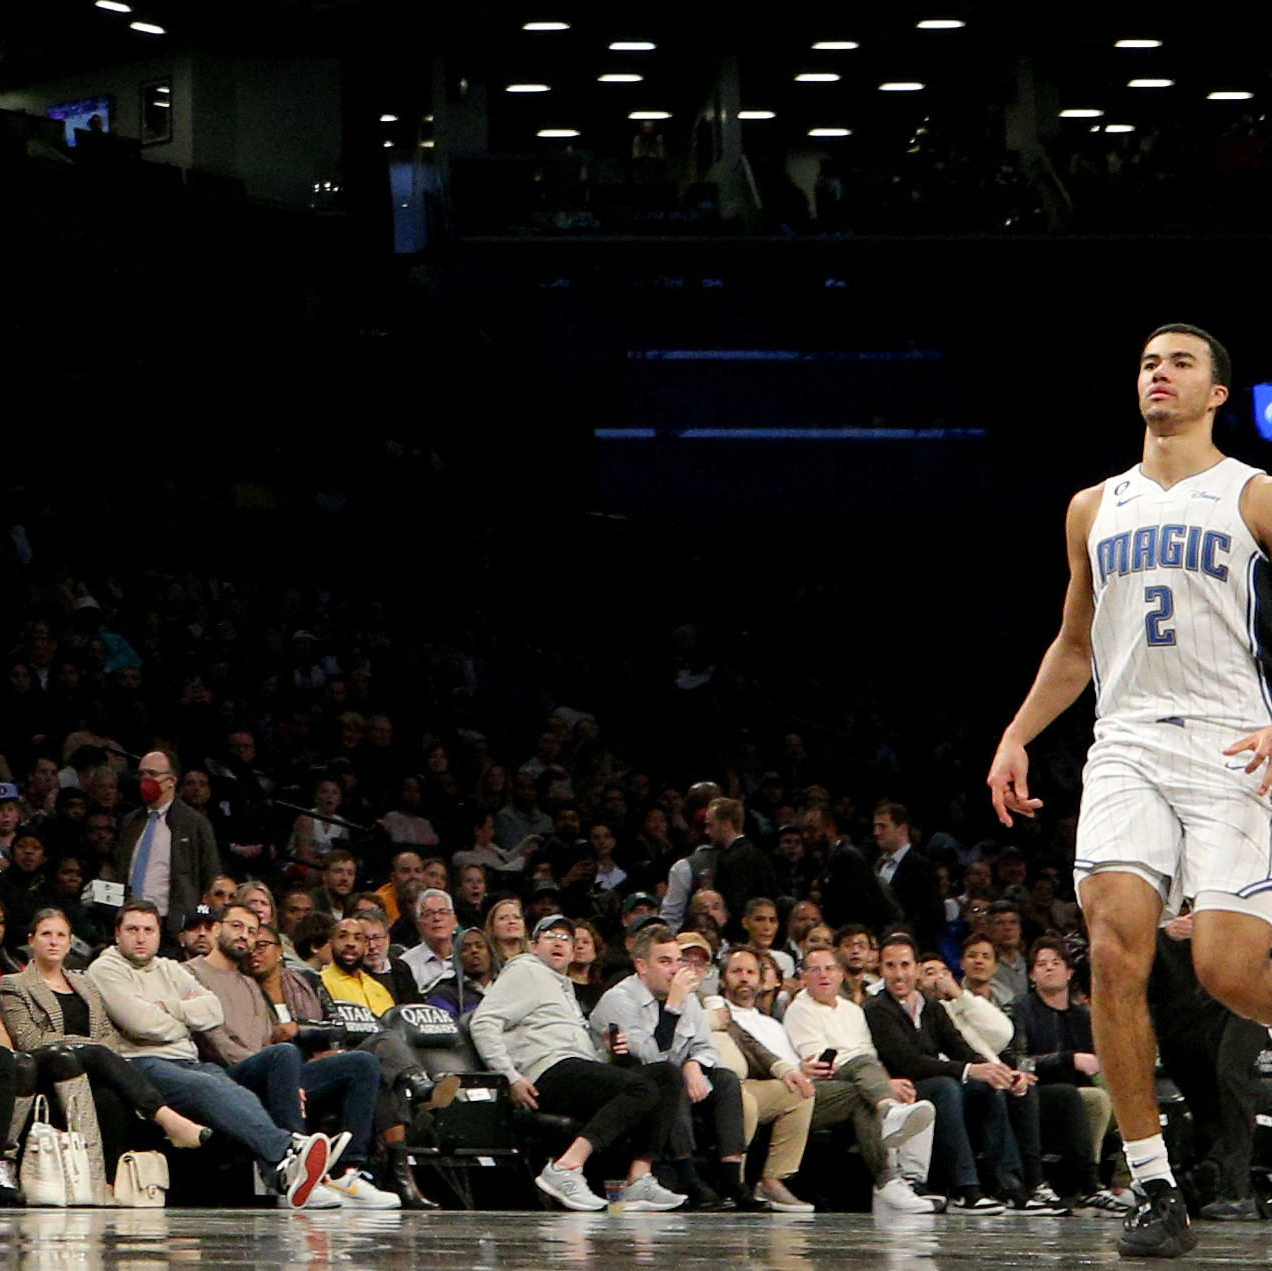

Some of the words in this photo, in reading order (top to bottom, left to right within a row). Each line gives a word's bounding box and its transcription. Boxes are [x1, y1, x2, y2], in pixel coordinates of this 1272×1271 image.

[1097, 524, 1232, 586] MAGIC
[1144, 585, 1177, 647] 2
[337, 1006, 376, 1023] ATAR
[400, 1007, 455, 1027] QATAR
